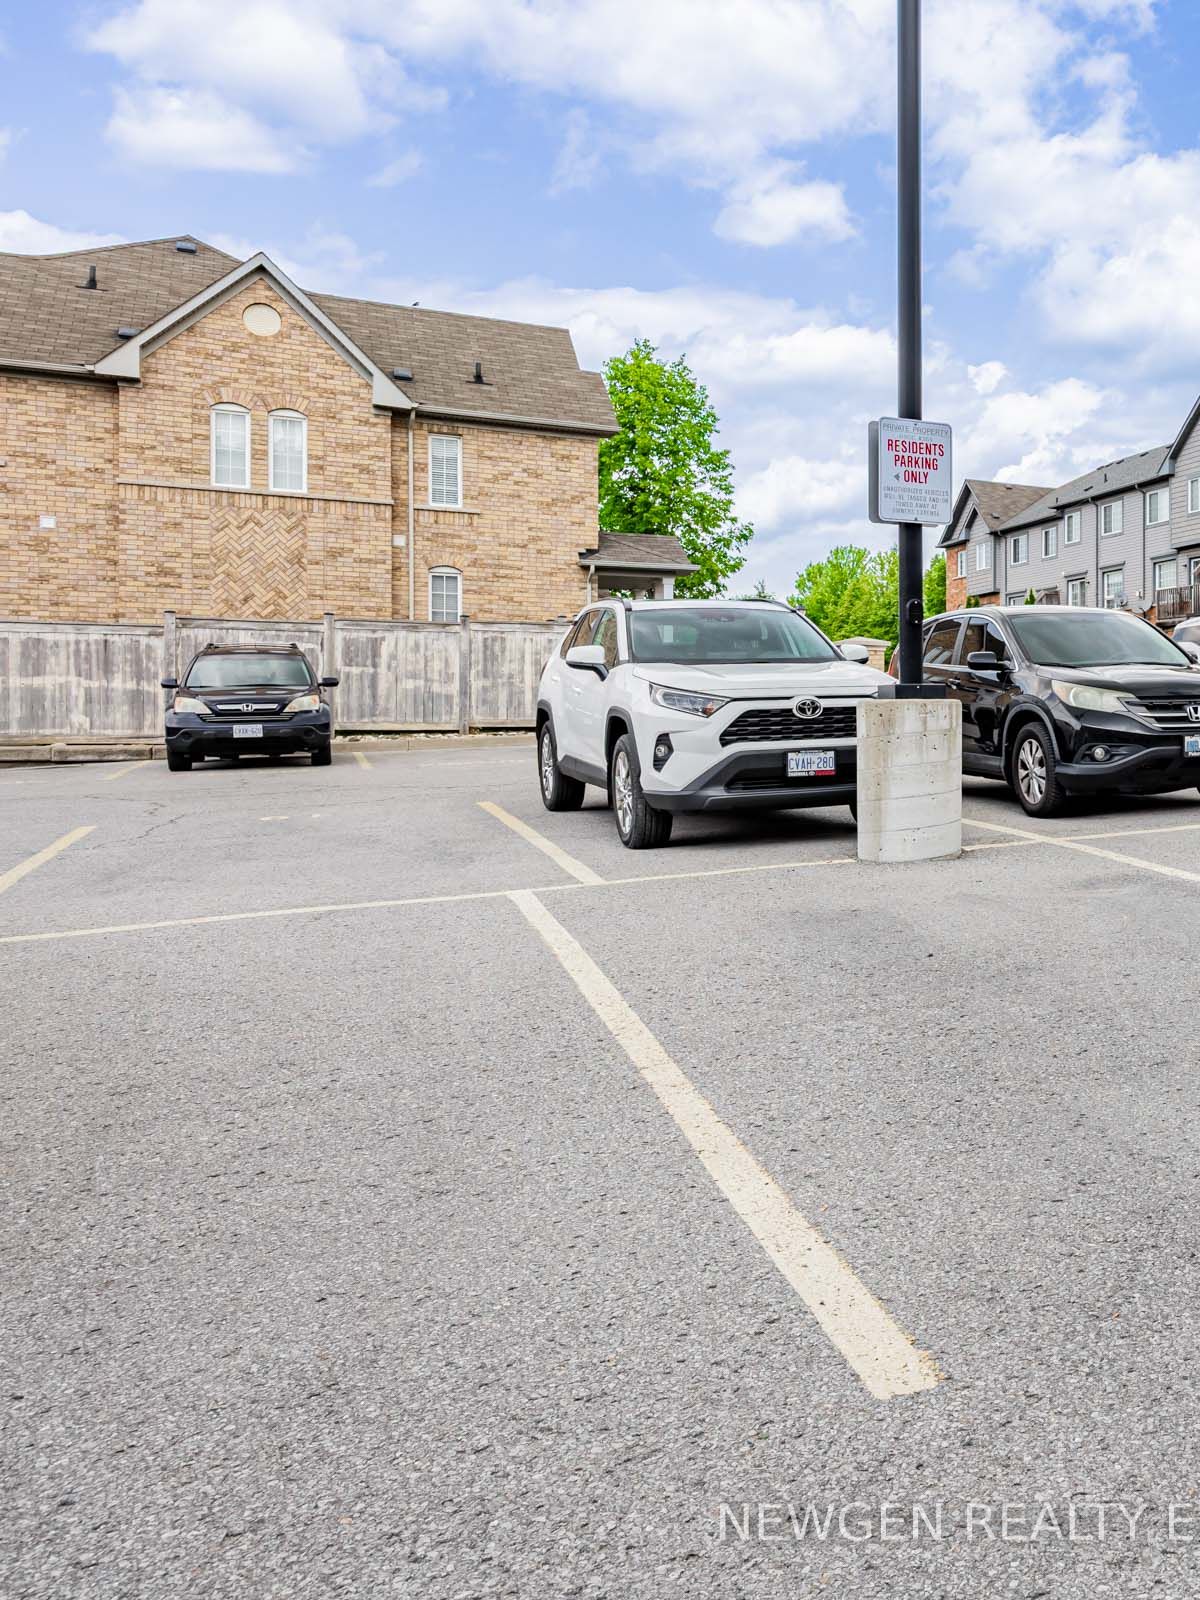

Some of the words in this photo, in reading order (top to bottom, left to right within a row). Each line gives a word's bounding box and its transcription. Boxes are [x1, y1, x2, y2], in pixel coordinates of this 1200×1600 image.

[913, 427, 949, 437] PROPERTY
[887, 439, 945, 457] RESIDENTS
[894, 454, 938, 471] PARKING
[903, 470, 929, 485] ONLY
